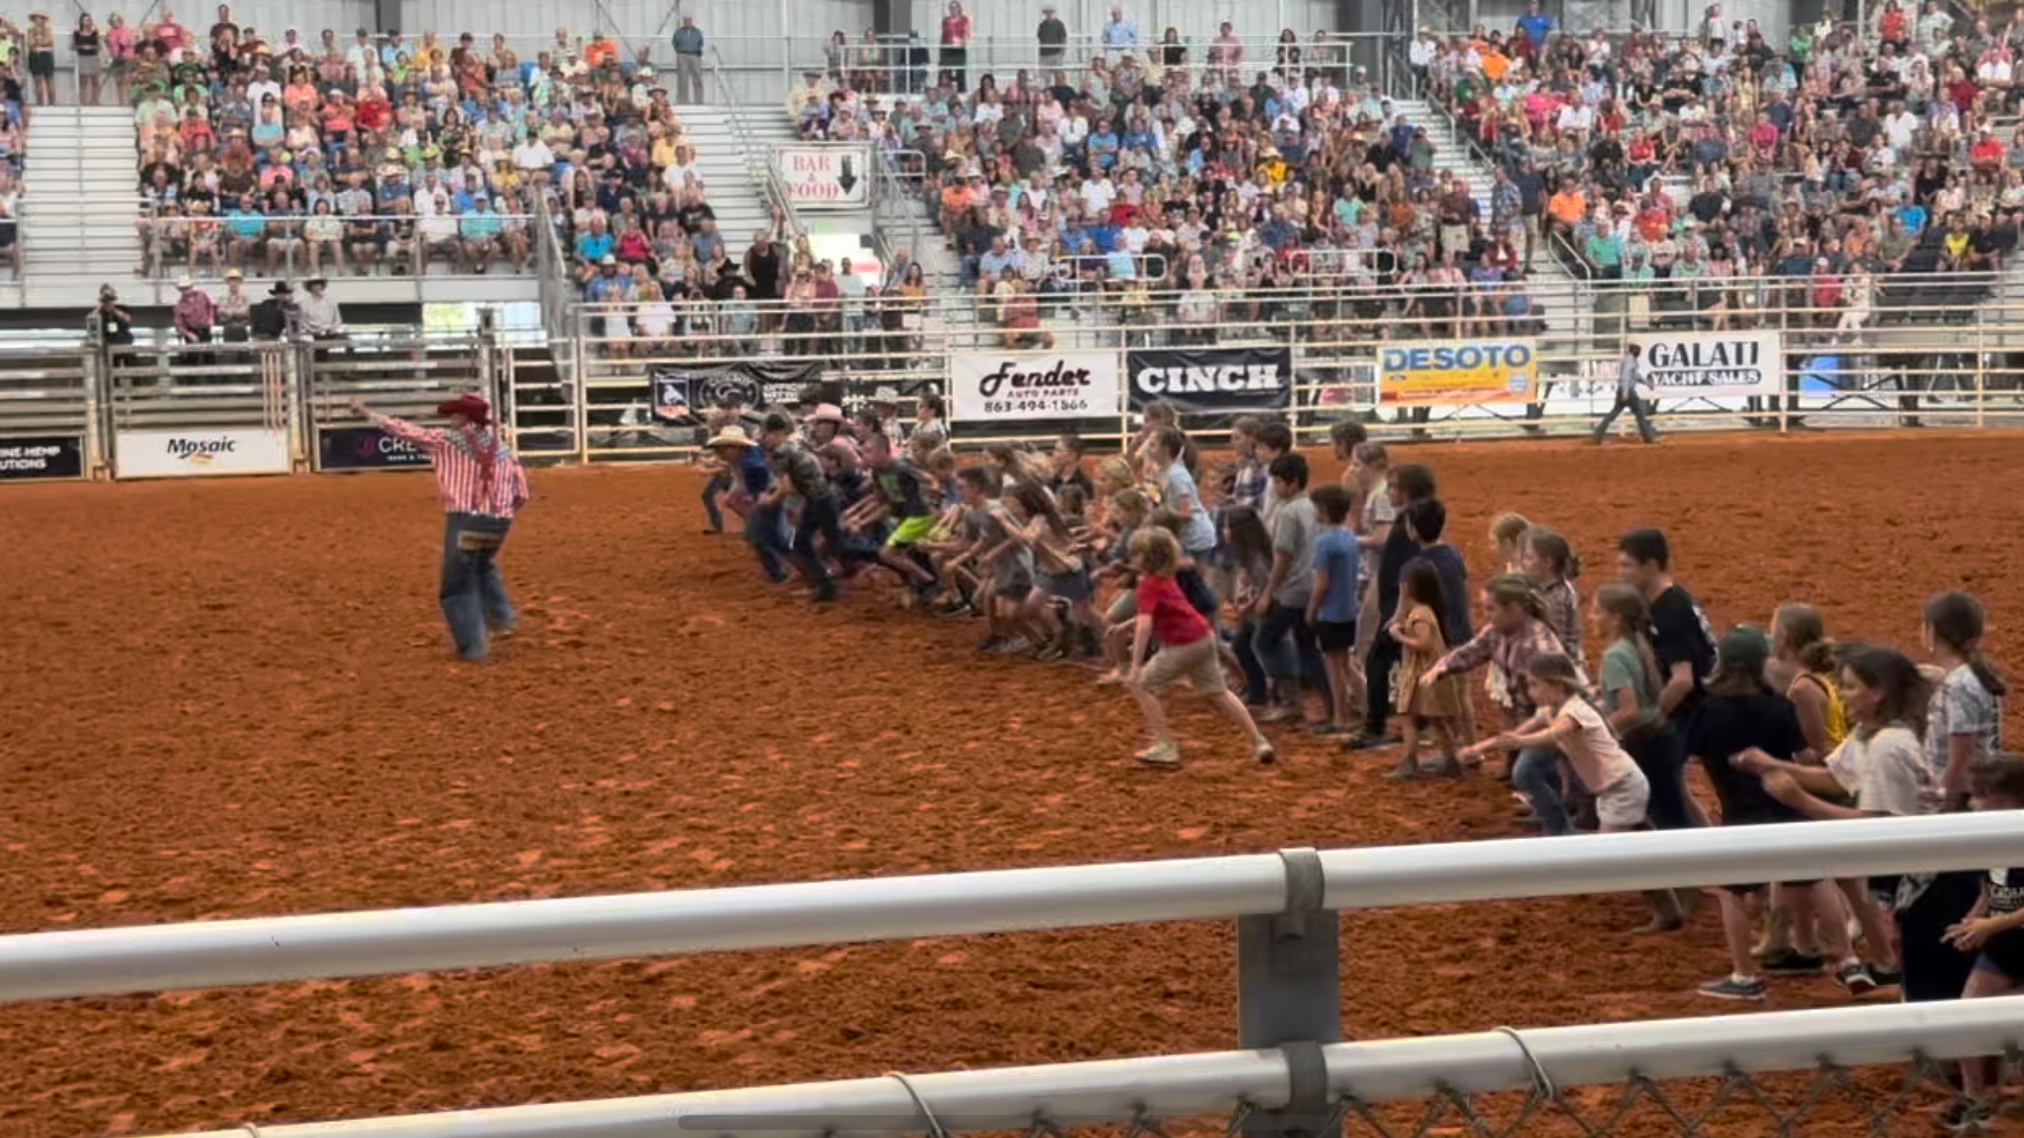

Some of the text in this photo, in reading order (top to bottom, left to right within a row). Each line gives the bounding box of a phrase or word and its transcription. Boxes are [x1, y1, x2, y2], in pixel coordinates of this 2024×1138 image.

[794, 155, 830, 171] BAR
[1384, 345, 1530, 371] DESOTO
[1648, 341, 1759, 367] GALATI
[979, 359, 1091, 397] Fender
[1137, 364, 1282, 393] CINCH
[1651, 369, 1758, 386] YACHT SALES
[1006, 387, 1079, 399] AUTO PARTS
[166, 435, 236, 454] Mosaic
